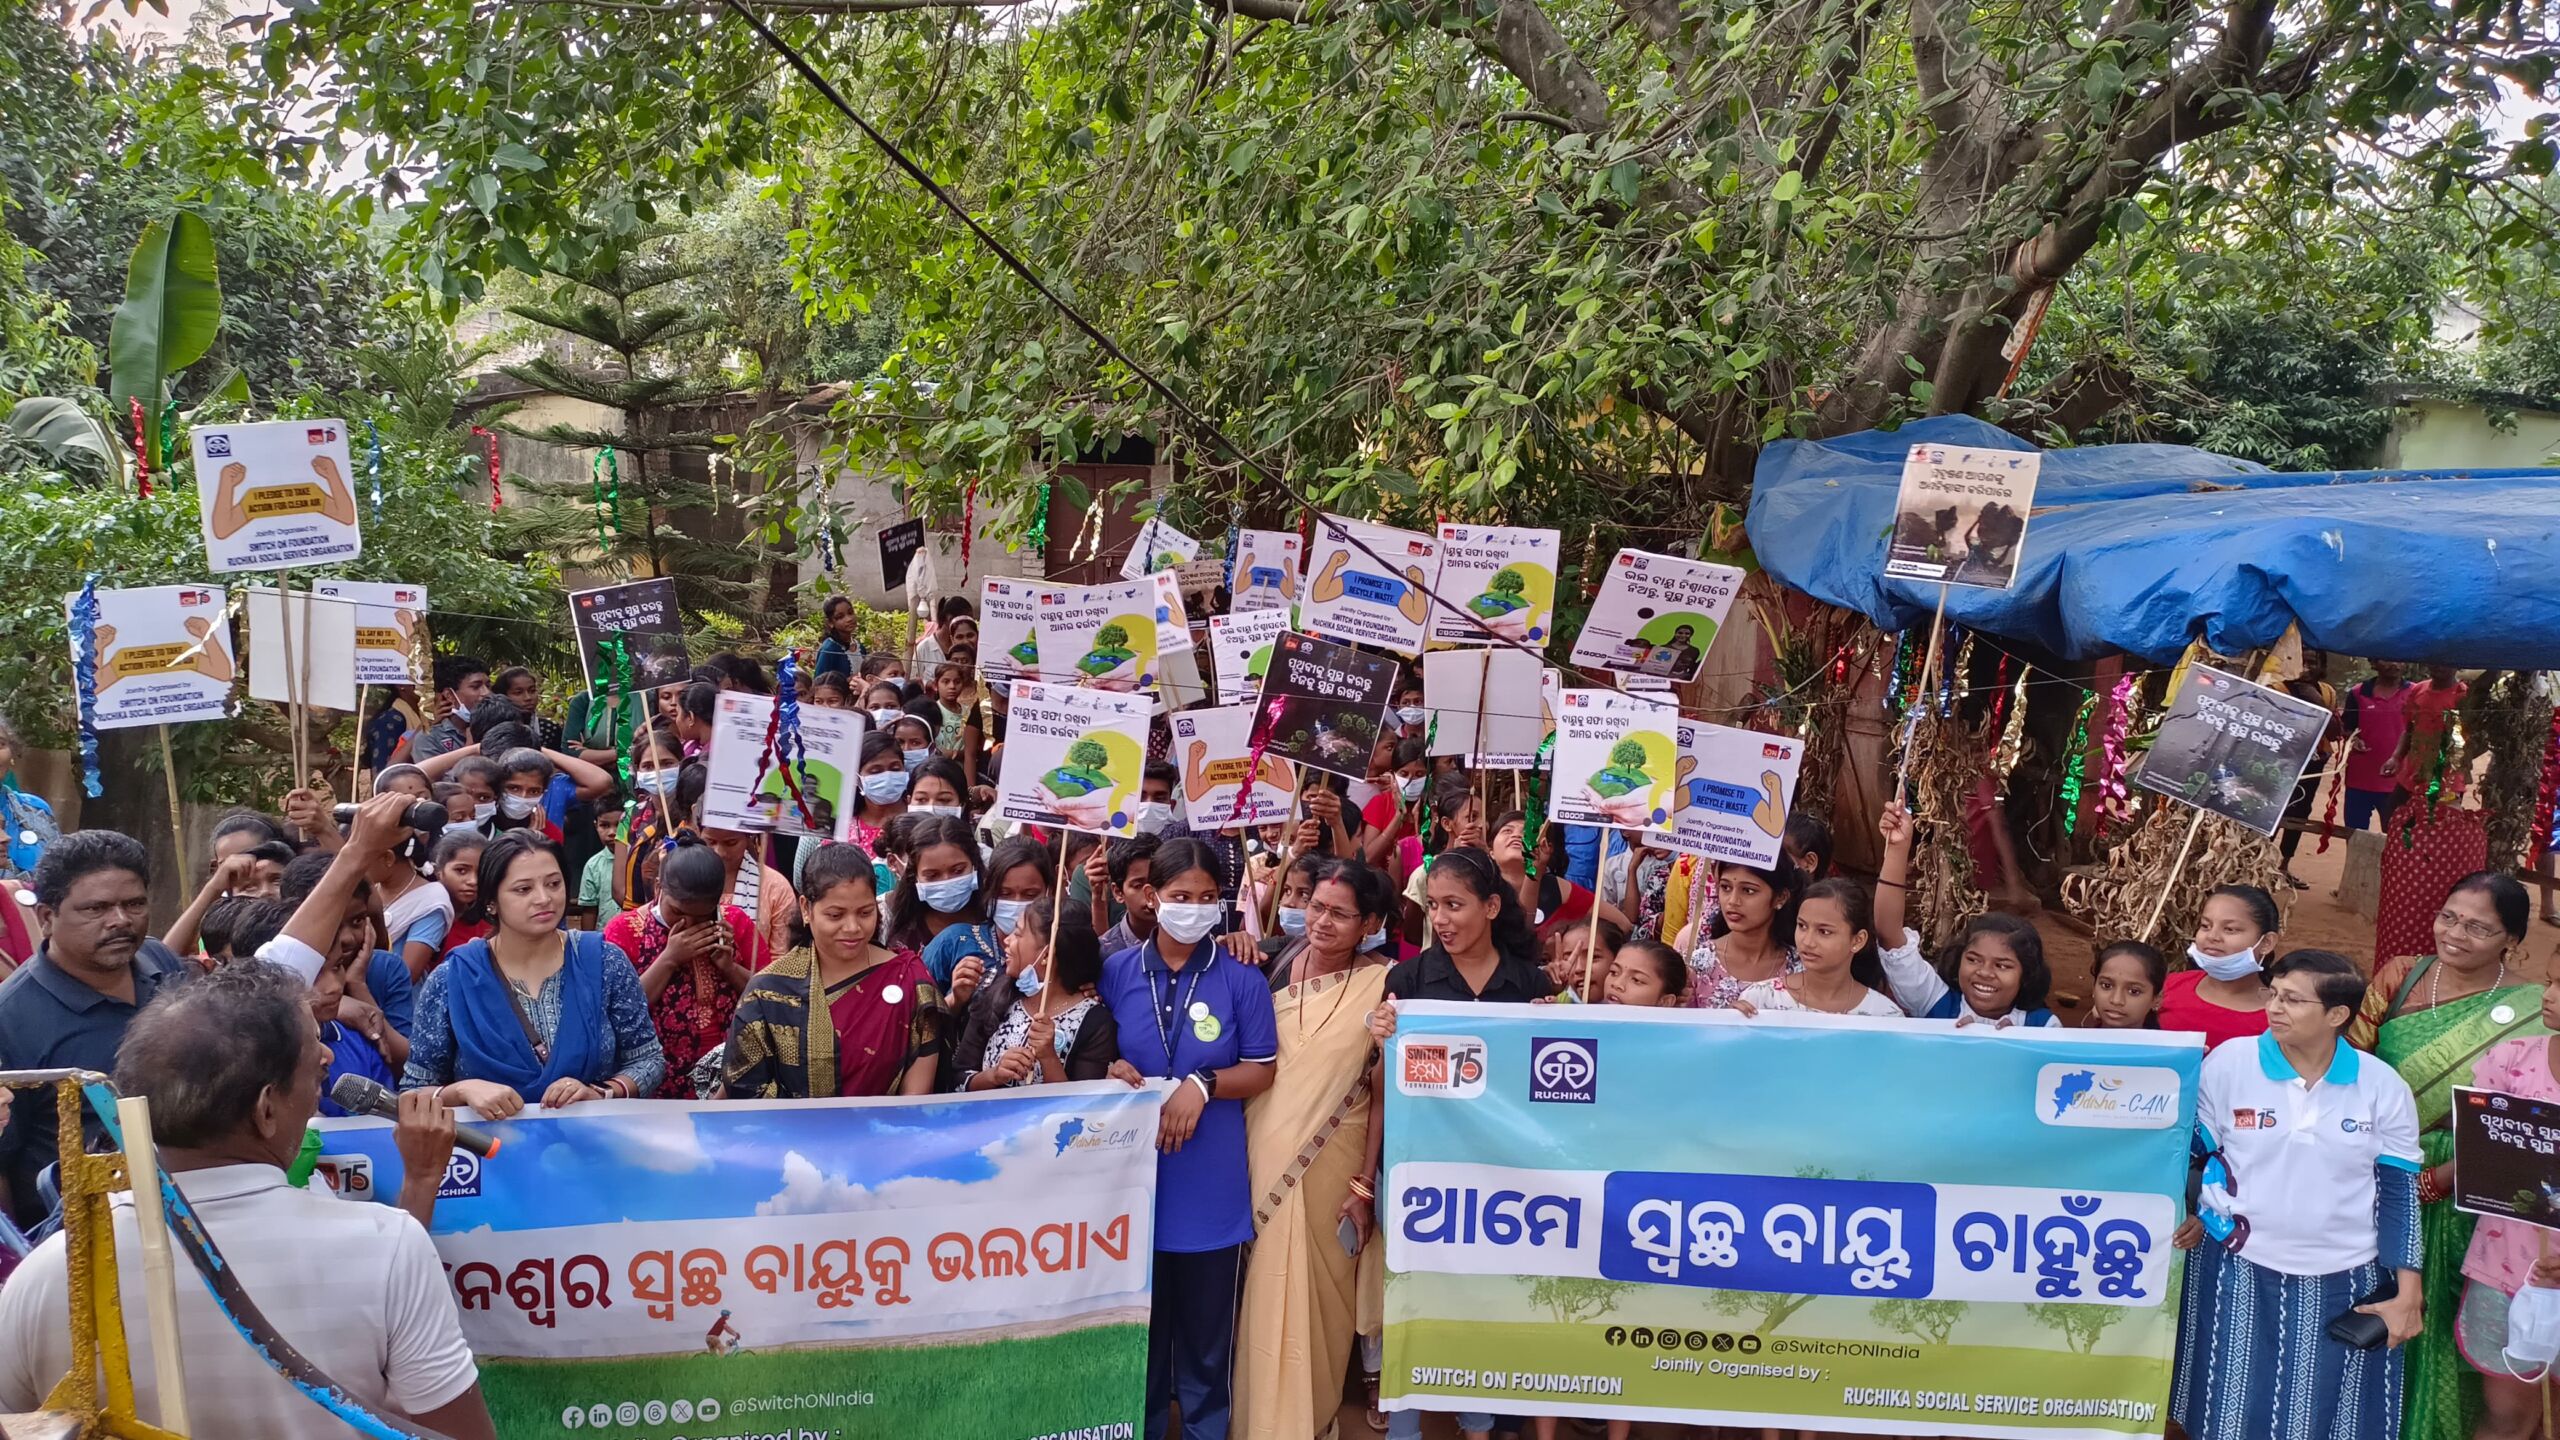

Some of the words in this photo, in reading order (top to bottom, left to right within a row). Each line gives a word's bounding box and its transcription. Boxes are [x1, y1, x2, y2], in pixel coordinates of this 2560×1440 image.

[258, 489, 283, 500] PLEDGE
[285, 489, 294, 497] TO
[295, 487, 311, 496] TAKE
[248, 503, 272, 513] ACTION
[274, 501, 287, 511] FOR
[289, 500, 309, 509] CLEAN
[310, 499, 321, 507] AIR
[277, 526, 309, 536] Organised
[249, 541, 276, 552] SWITCH
[277, 540, 287, 549] ON
[288, 535, 329, 548] FOUNDATION
[227, 555, 258, 567] RUCHIKA
[259, 553, 282, 563] SOCIAL
[284, 550, 310, 561] SERVICE
[311, 544, 354, 557] ORGANISATION
[1358, 576, 1383, 589] PROMISE
[1384, 581, 1392, 589] TO
[1349, 586, 1373, 598] RECYCLE
[1374, 590, 1394, 603] WASTE
[1357, 609, 1384, 620] Organised
[1332, 613, 1353, 624] SWITCH
[1354, 618, 1362, 626] ON
[1362, 620, 1398, 634] FOUNDATION
[1312, 618, 1335, 630] RUCHIKA
[1336, 623, 1354, 634] SOCIAL
[1355, 628, 1377, 639] SERVICE
[1377, 632, 1415, 647] ORGANISATION
[129, 650, 154, 659] PLEDGE
[157, 649, 165, 657] TO
[119, 661, 143, 671] ACTION
[145, 660, 158, 669] FOR
[147, 684, 181, 693] Organised
[119, 698, 147, 708] SWITCH
[148, 697, 158, 705] ON
[159, 691, 204, 704] FOUNDATION
[129, 708, 153, 718] SOCIAL
[154, 705, 182, 716] SERVICE
[1217, 762, 1234, 771] PLEDGE
[1210, 772, 1228, 781] ACTION
[1228, 771, 1238, 779] FOR
[1706, 784, 1735, 798] PROMISE
[1736, 790, 1745, 799] TO
[1212, 804, 1232, 812] SWITCH
[1696, 795, 1724, 808] RECYCLE
[1725, 800, 1748, 813] WASTE
[1198, 814, 1219, 823] RUCHIKA
[1686, 817, 1705, 827] Jointly
[1706, 820, 1736, 833] Organised
[1736, 826, 1744, 835] by
[1678, 826, 1701, 838] SWITCH
[1702, 831, 1711, 840] ON
[1712, 834, 1751, 848] FOUNDATION
[1655, 833, 1681, 846] RUCHIKA
[1682, 838, 1702, 849] SOCIAL
[1704, 843, 1728, 855] SERVICE
[1729, 847, 1772, 863] ORGANISATION
[1407, 1048, 1445, 1061] SWITCH
[1450, 1048, 1483, 1088] 15
[1534, 1090, 1591, 1101] RUCHIKA
[2257, 1110, 2277, 1130] 15
[340, 1164, 369, 1193] 15
[1401, 1186, 1582, 1250] ଆମେ
[1762, 1202, 1912, 1291] ବାୟୁ
[1952, 1195, 2152, 1300] ଚାହୁଁଛୁ
[744, 1236, 912, 1310] ବାୟୁକୁ
[926, 1213, 1131, 1282] ଭଲପାଏ
[1770, 1339, 1920, 1360] @SwitchONIndia
[1651, 1354, 1704, 1375] Jointly
[1708, 1358, 1795, 1379] Organised
[1798, 1361, 1822, 1383] by
[1411, 1367, 1477, 1388] SWITCH
[1481, 1370, 1507, 1390] ON
[1511, 1371, 1623, 1395] FOUNDATION
[729, 1390, 874, 1417] @SwitchONIndia
[1843, 1387, 1912, 1408] RUCHIKA
[1915, 1390, 1971, 1412] SOCIAL
[1974, 1394, 2040, 1416] SERVICE
[2042, 1397, 2157, 1423] ORGANISATION
